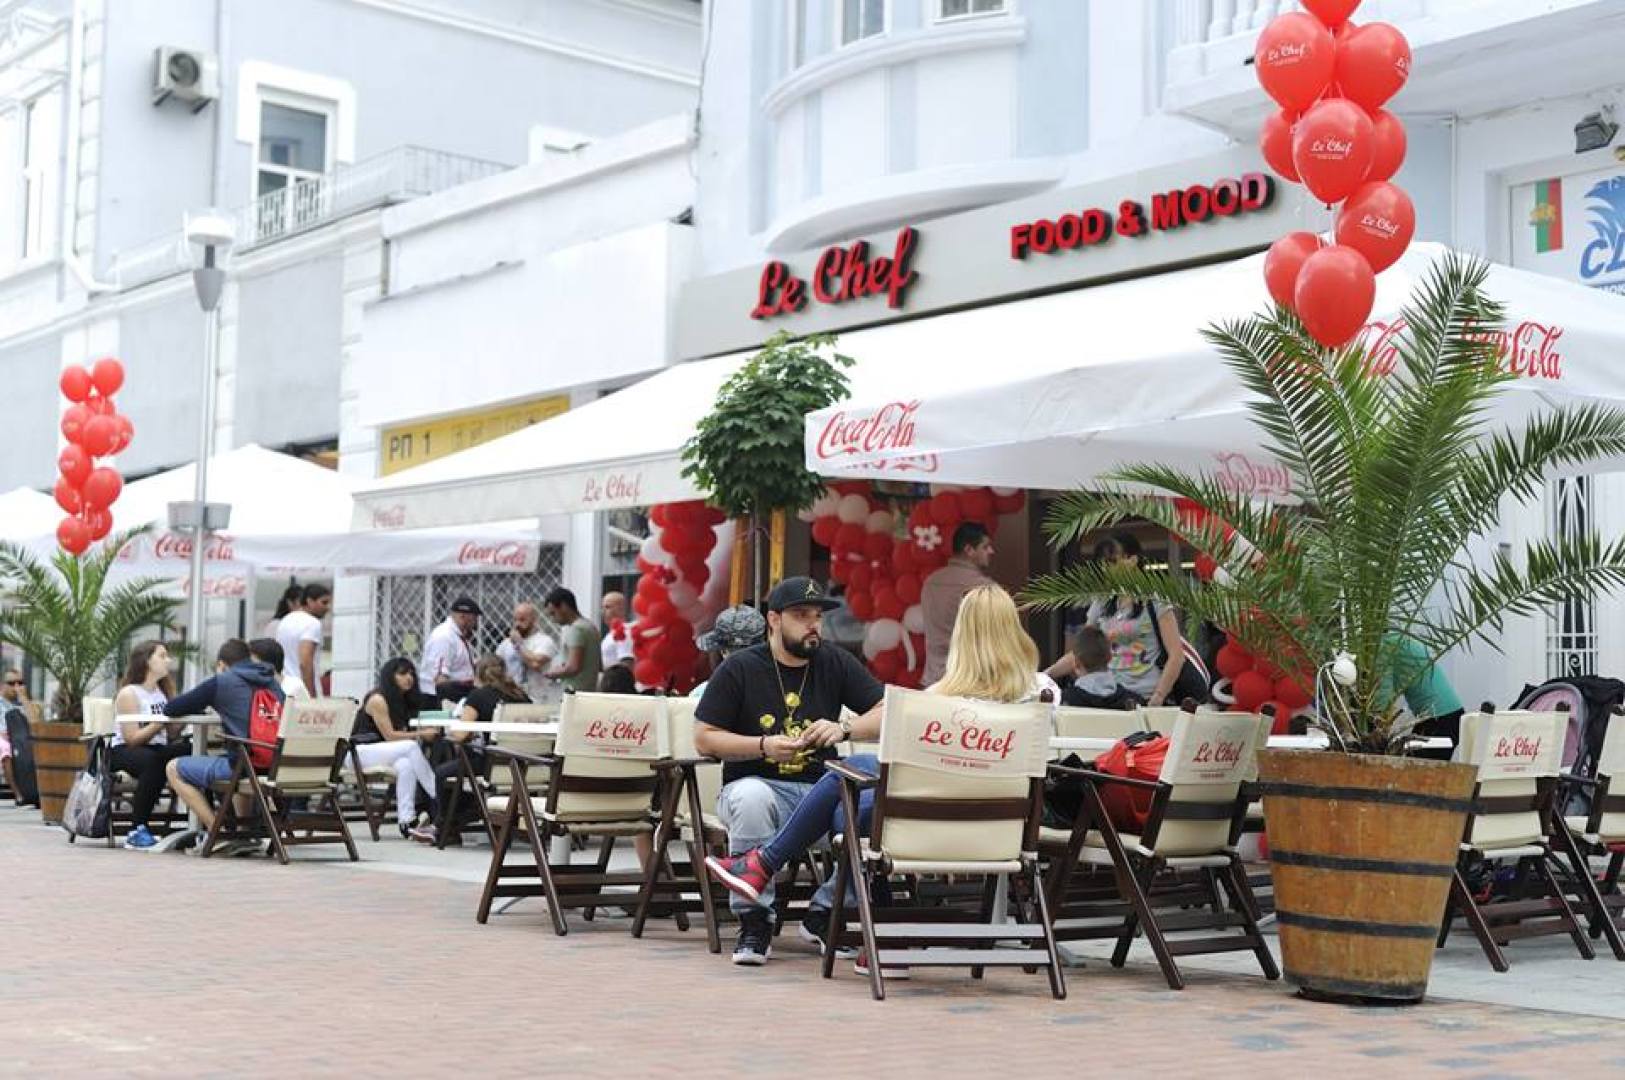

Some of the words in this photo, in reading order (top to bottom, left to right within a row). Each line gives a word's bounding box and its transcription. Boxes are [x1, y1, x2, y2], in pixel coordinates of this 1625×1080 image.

[1311, 141, 1325, 152] Le
[1326, 140, 1352, 157] Chef
[1011, 208, 1112, 260] FOOD
[1117, 200, 1147, 237] &
[1151, 172, 1275, 232] MOOD
[1361, 214, 1375, 227] Le
[1377, 216, 1400, 236] Chef
[750, 260, 809, 320] Le
[813, 225, 919, 309] Chef
[1460, 316, 1564, 380] Ca-Cola
[582, 478, 603, 502] Le
[605, 472, 642, 504] Chef
[155, 533, 235, 562] Cocaola
[584, 720, 608, 740] Le
[612, 721, 651, 746] Chef
[919, 720, 953, 746] Le
[960, 725, 1016, 760] Chef
[1494, 736, 1511, 758] Le
[1513, 735, 1542, 762] Chef
